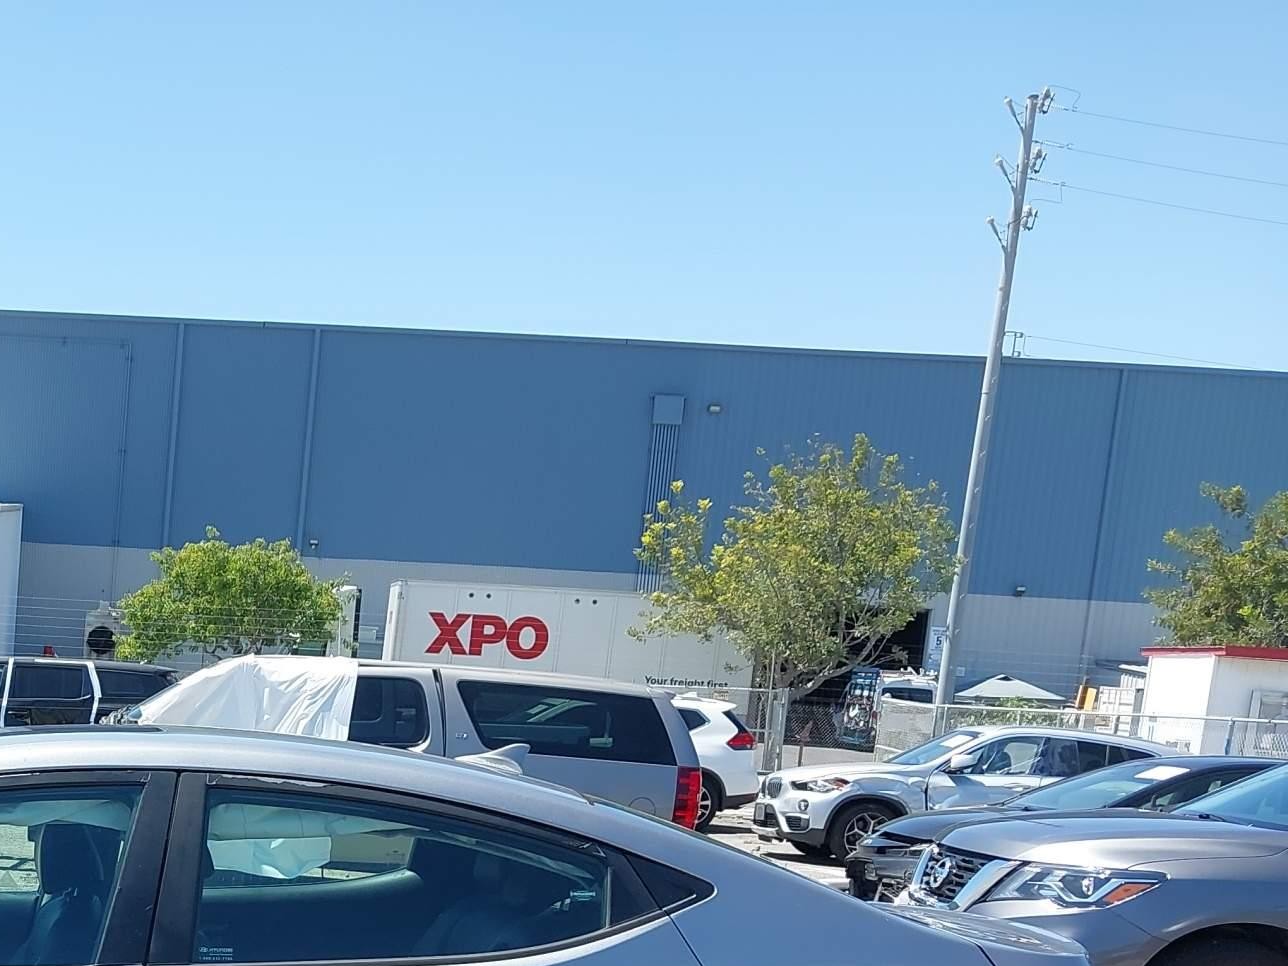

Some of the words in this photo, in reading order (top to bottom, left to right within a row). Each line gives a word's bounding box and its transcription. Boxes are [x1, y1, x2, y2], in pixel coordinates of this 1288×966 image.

[424, 611, 550, 660] XPO
[935, 636, 942, 646] 5
[645, 675, 668, 686] Your
[670, 677, 704, 688] freight
